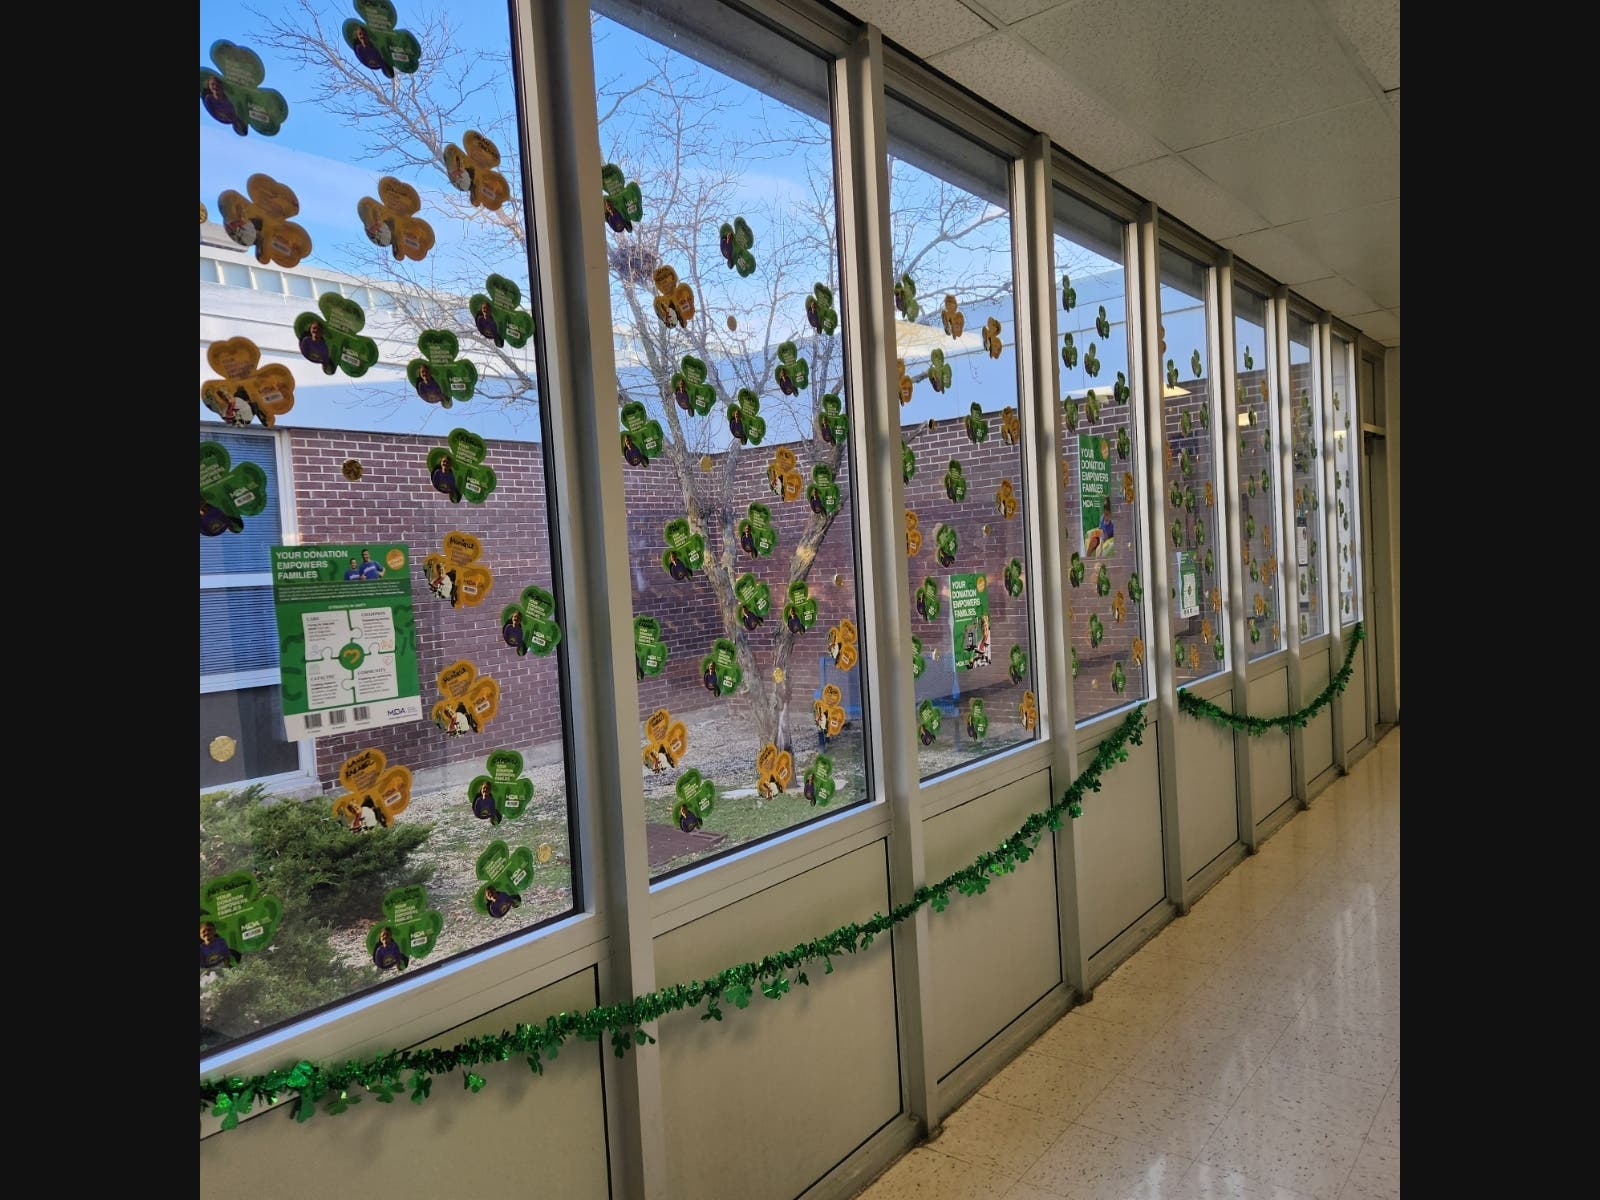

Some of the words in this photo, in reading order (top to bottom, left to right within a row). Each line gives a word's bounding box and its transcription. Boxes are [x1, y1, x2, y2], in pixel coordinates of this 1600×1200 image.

[1081, 448, 1094, 459] YOUR
[1081, 460, 1106, 471] DONATION
[1081, 472, 1109, 482] EMPOWERS
[1082, 483, 1104, 494] FAMILIES
[276, 551, 302, 560] YOUR
[303, 550, 349, 559] DONATION
[277, 560, 329, 570] EMPOWERS
[277, 570, 319, 580] FAMILIES
[952, 581, 966, 590] YOUR
[952, 590, 977, 599] DONATION
[952, 599, 981, 608] EMPOWERS
[954, 608, 977, 618] FAMILIES
[387, 707, 406, 717] MDA
